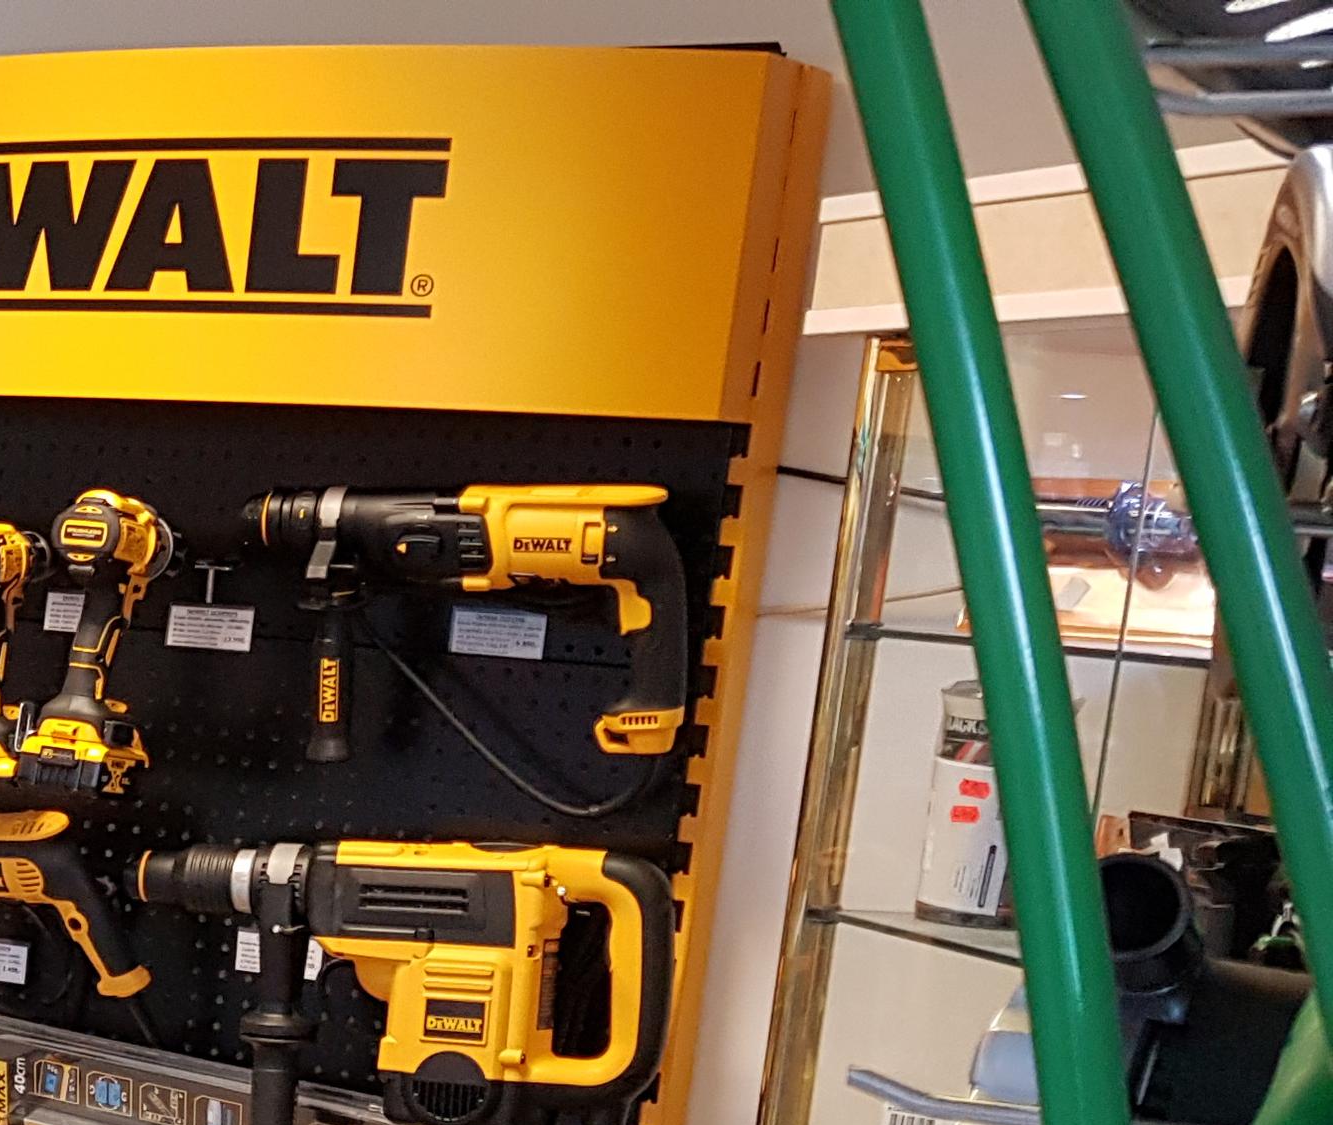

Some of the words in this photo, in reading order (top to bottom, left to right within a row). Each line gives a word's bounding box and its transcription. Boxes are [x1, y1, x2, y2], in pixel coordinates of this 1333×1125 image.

[514, 537, 572, 552] DEWALT
[320, 659, 338, 722] DEWALT
[426, 1016, 482, 1034] DEWALT
[14, 1057, 25, 1094] 40cm
